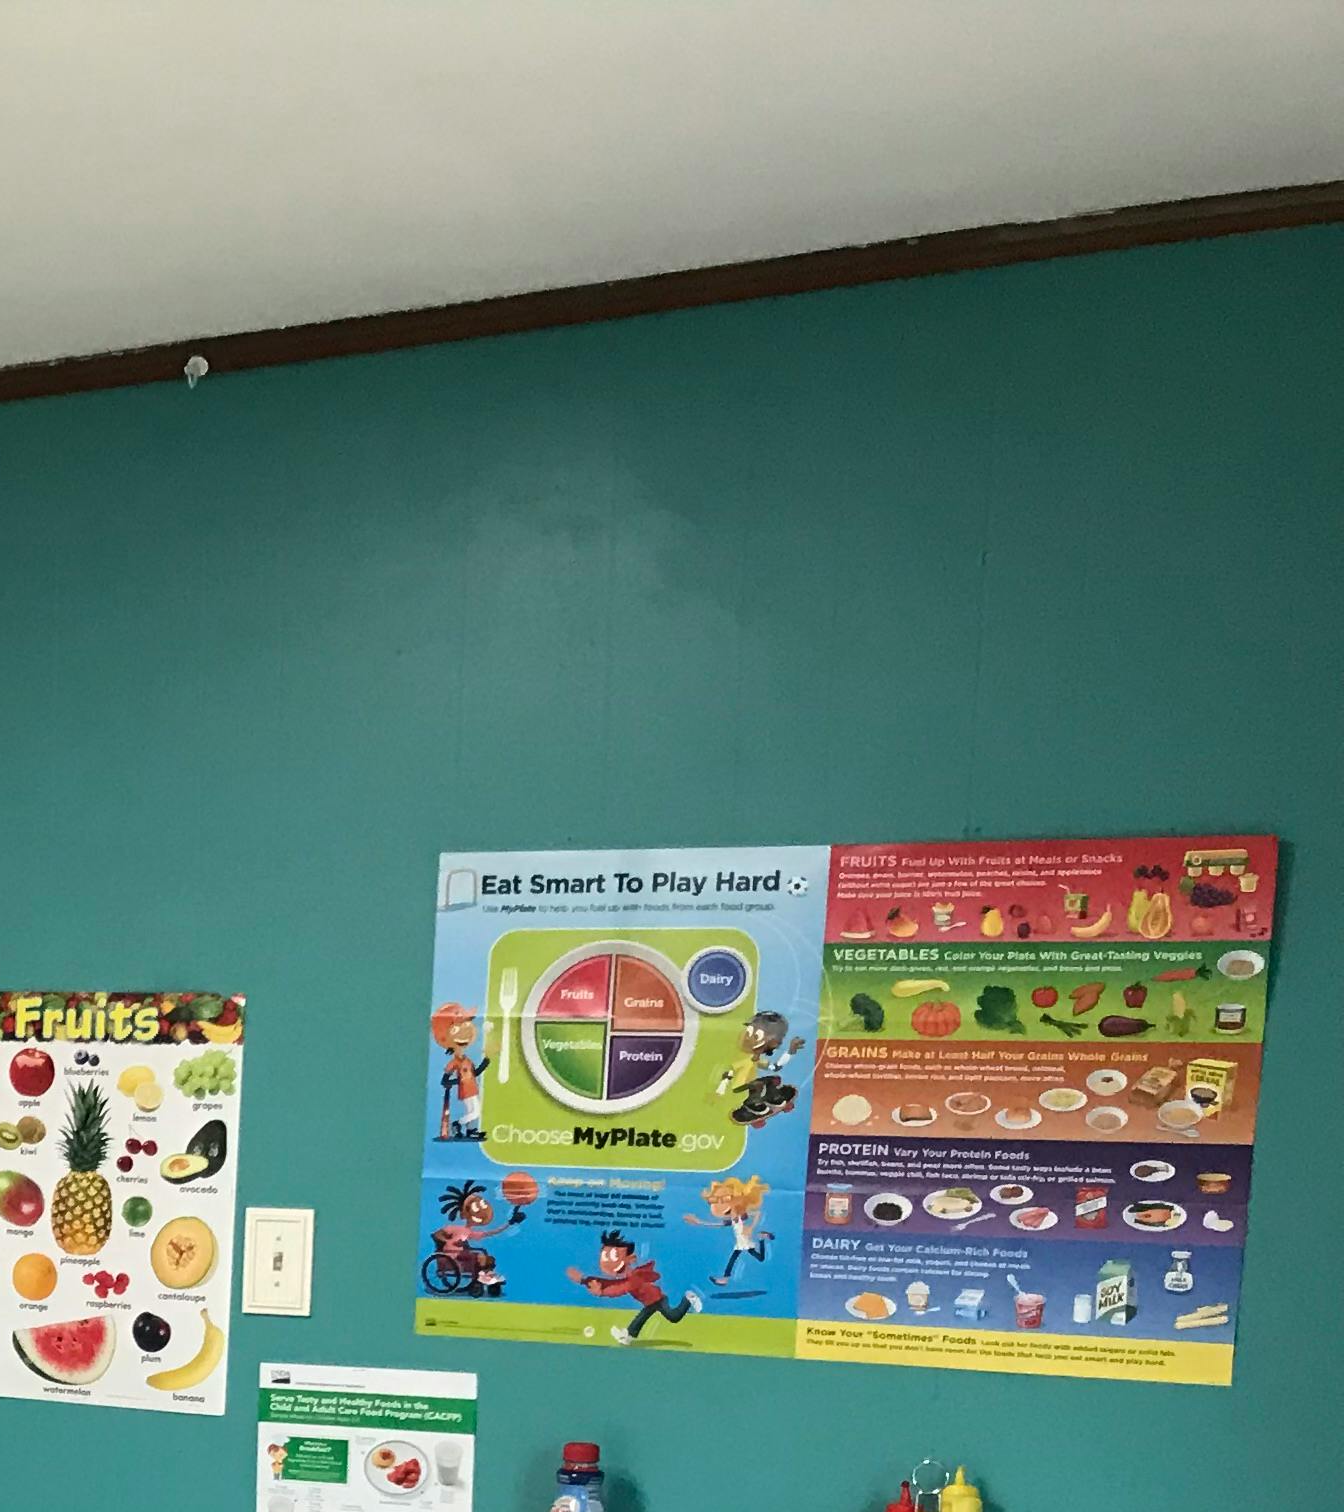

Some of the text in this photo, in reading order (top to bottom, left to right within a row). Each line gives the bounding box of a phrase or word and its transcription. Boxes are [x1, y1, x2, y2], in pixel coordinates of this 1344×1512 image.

[840, 855, 897, 868] FRUITS
[481, 870, 780, 897] Eat Smart To Play Hard
[833, 948, 939, 961] VEGETABLES
[700, 973, 734, 987] Dairy
[561, 990, 594, 1000] Fruits
[624, 998, 664, 1008] Grains
[13, 998, 161, 1043] Fruits
[542, 1039, 603, 1053] Vegetables
[619, 1050, 663, 1062] Protein
[825, 1046, 888, 1059] GRAINS
[63, 1067, 110, 1077] blueberries
[18, 1099, 40, 1108] apple
[192, 1102, 223, 1113] grapes
[132, 1114, 157, 1122] lemon
[492, 1123, 725, 1152] ChooseMyPlate.gov
[20, 1147, 37, 1156] kiwi
[819, 1142, 889, 1156] PROTEIN
[116, 1175, 149, 1185] cherries
[179, 1185, 218, 1194] avocado
[6, 1228, 34, 1239] mango
[128, 1230, 146, 1239] lime
[812, 1237, 861, 1251] DAIRY
[59, 1256, 101, 1267] pineapple
[157, 1293, 207, 1303] cantaloupe
[19, 1302, 49, 1312] orange
[86, 1299, 132, 1311] raspberries
[140, 1354, 162, 1364] plum
[42, 1386, 91, 1397] watermelon
[172, 1393, 206, 1404] banana
